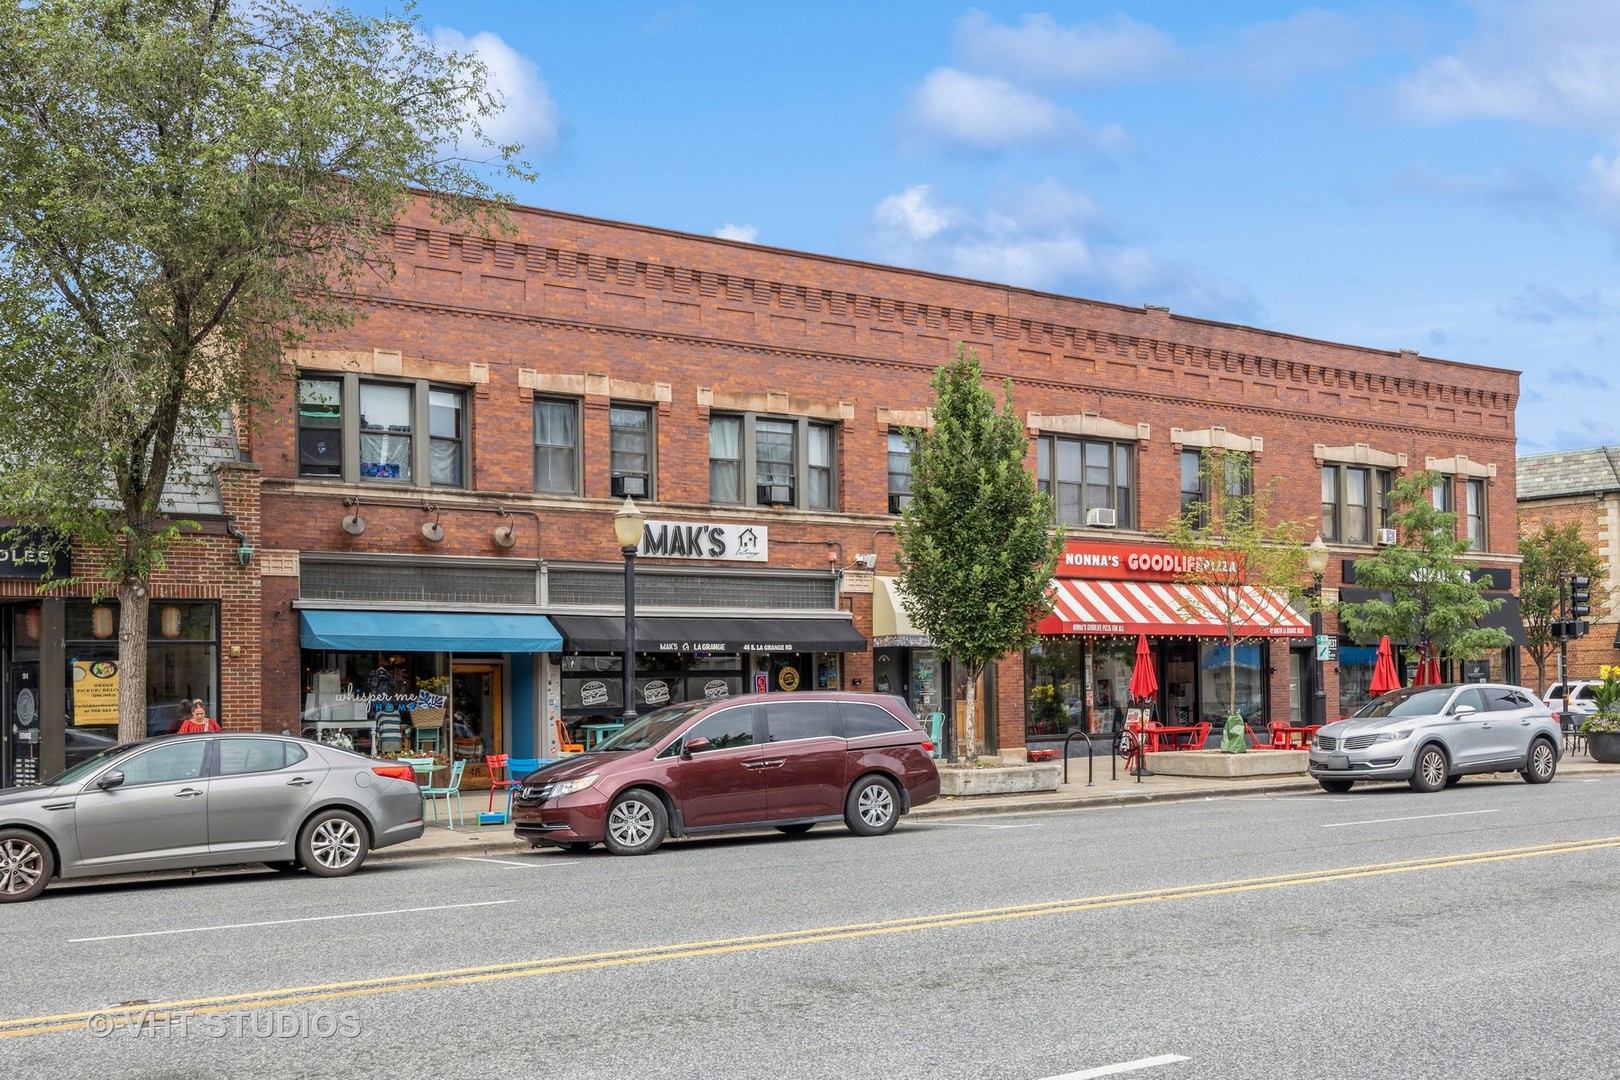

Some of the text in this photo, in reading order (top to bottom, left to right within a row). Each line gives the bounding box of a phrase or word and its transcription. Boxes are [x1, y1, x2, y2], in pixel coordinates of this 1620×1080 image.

[644, 524, 726, 557] MAK'S
[1065, 553, 1119, 567] NONNA'S
[1128, 553, 1203, 573] GOODLIFE
[660, 643, 726, 651] MAK'S LA GRANGE
[335, 682, 418, 713] whisper me
